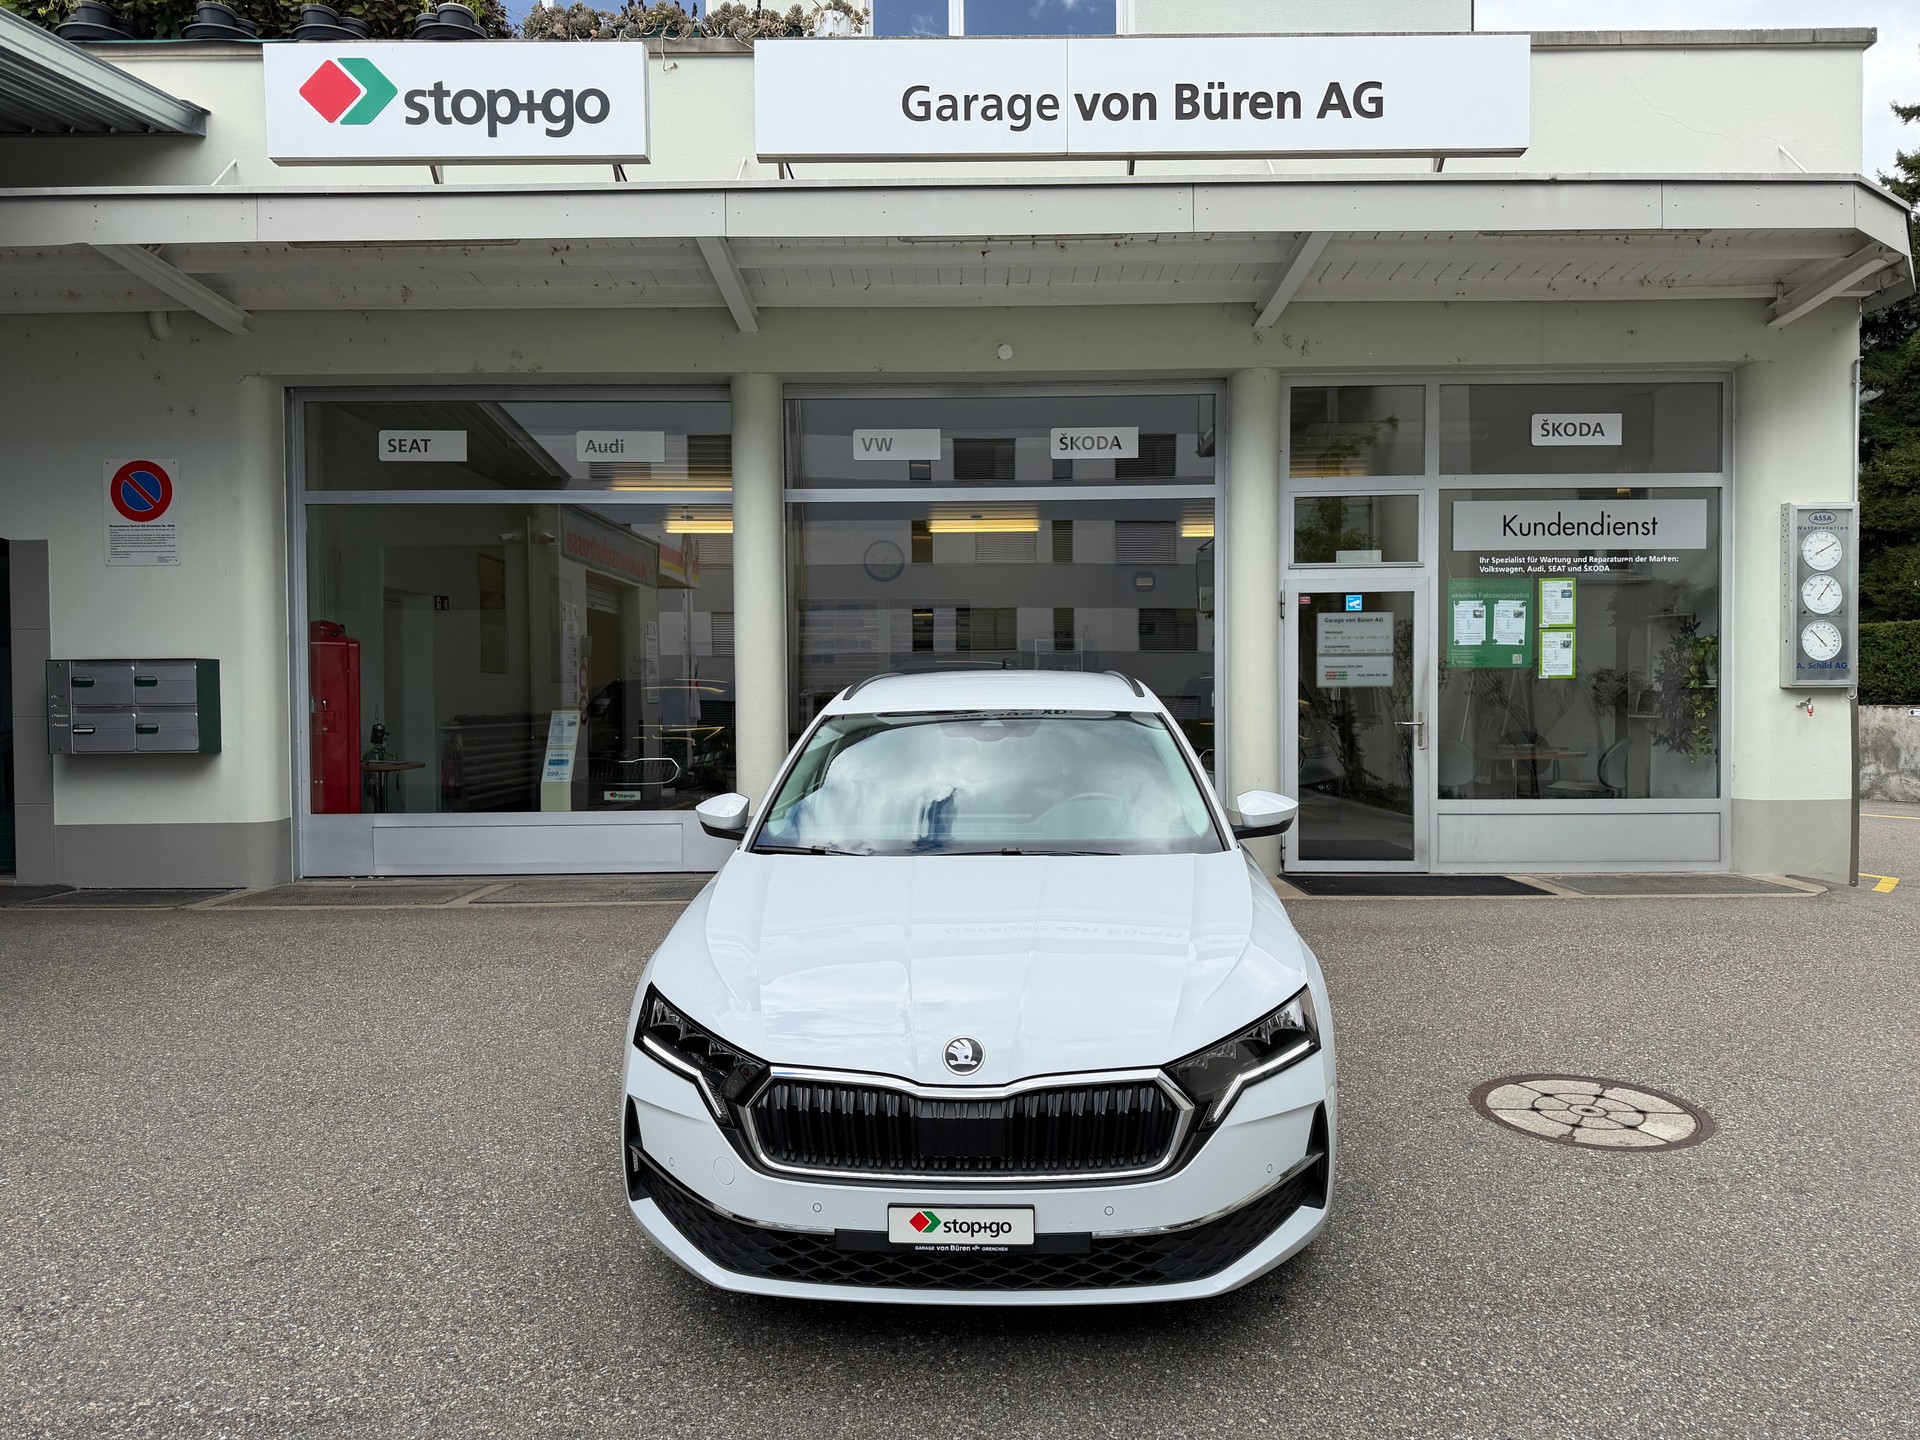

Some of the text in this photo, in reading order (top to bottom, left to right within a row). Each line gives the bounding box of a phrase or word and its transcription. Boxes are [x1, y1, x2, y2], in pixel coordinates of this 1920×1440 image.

[404, 80, 611, 138] stop+go
[901, 81, 1384, 131] Garage von Büren AG
[1540, 418, 1606, 438] ŠKODA
[387, 438, 432, 453] SEAT
[584, 438, 625, 454] Audi
[861, 437, 893, 451] VW
[1059, 433, 1123, 451] ŠKODA
[1502, 511, 1659, 538] Kundendienst
[1479, 556, 1490, 564] Ihr
[1491, 556, 1526, 565] Spezialist
[1527, 556, 1538, 564] für
[1539, 556, 1571, 565] Wartung
[1589, 556, 1634, 565] Reparaturen
[1635, 555, 1647, 563] der
[1649, 555, 1679, 563] Marken:
[1479, 565, 1525, 574] Volkswagen,
[1527, 565, 1547, 573] Audi,
[1583, 564, 1611, 572] ŠKODA
[1451, 591, 1530, 600] aktuelles Fahrzeugangebot
[1796, 661, 1848, 670] A. Schild AG
[943, 1219, 1013, 1238] stop+go
